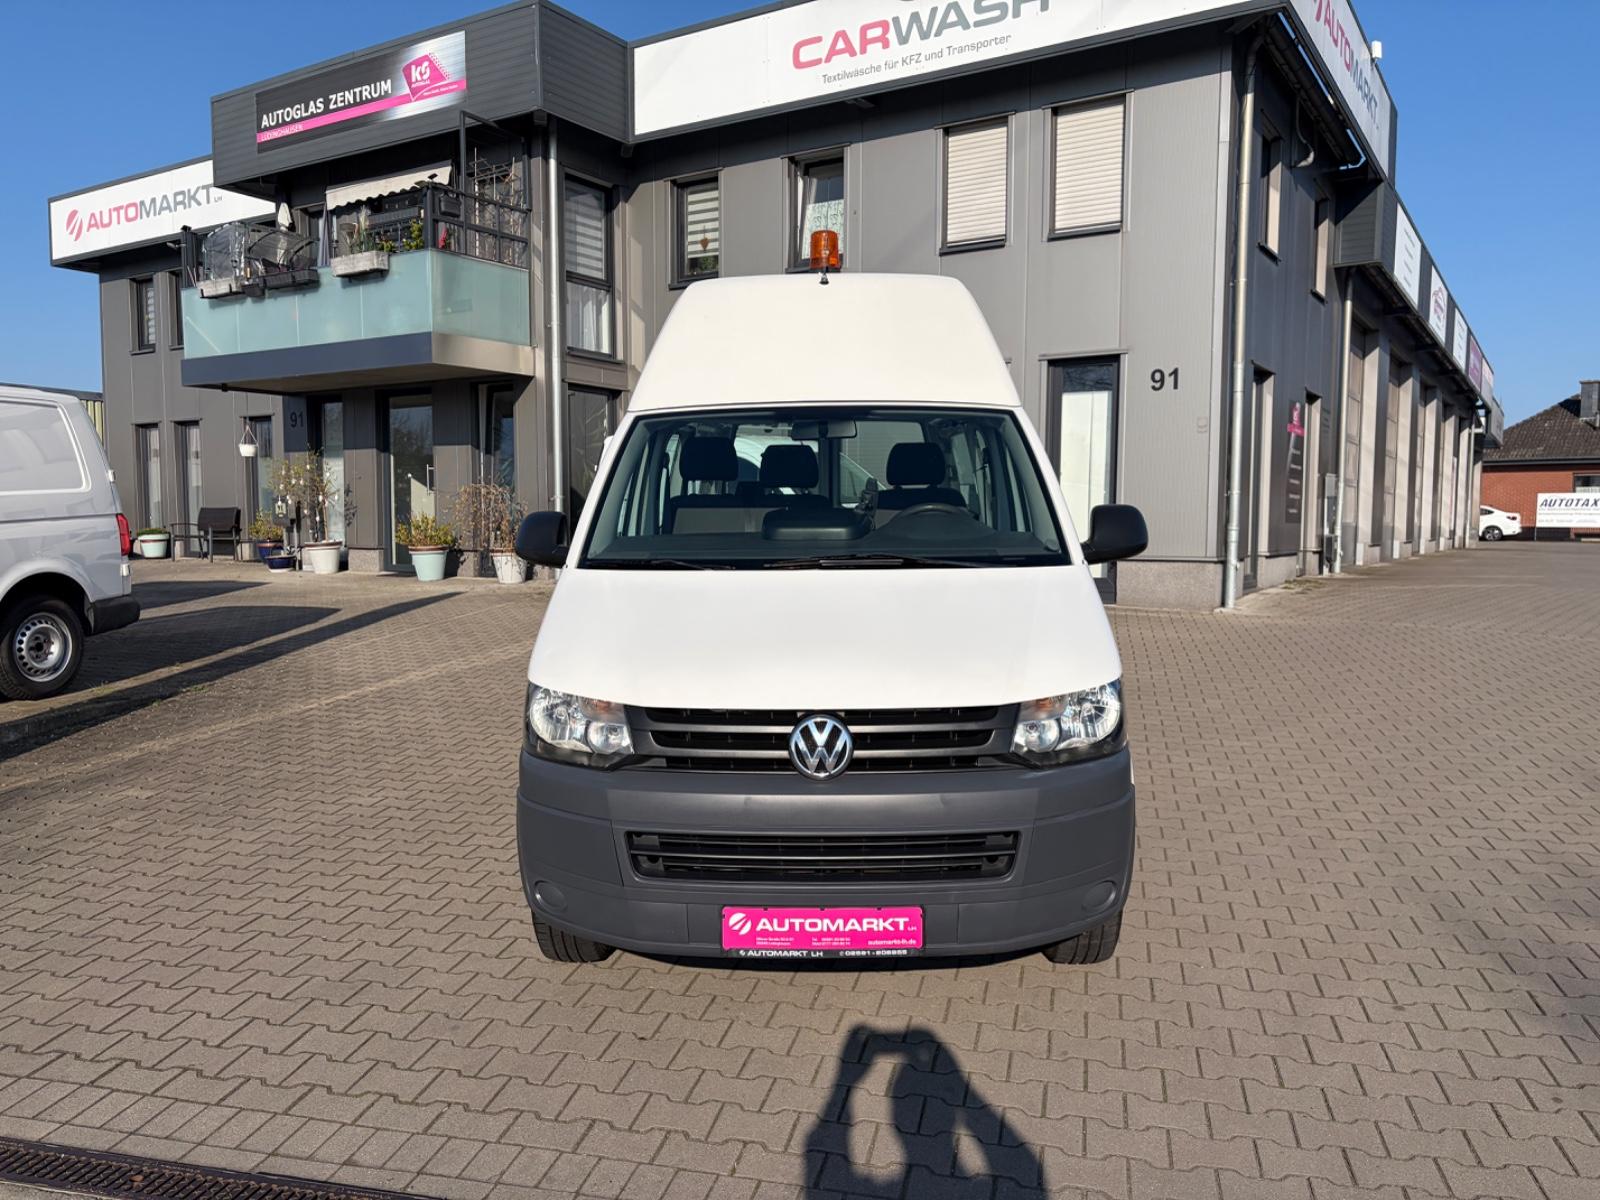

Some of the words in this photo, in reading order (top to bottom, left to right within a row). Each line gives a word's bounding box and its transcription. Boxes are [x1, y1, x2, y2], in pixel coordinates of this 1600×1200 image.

[822, 64, 881, 84] Textilwäsche
[883, 58, 899, 71] für
[901, 53, 922, 67] KFZ
[924, 50, 943, 62] und
[946, 34, 1011, 57] Transporter
[1323, 0, 1377, 124] AUTOMARKT
[261, 98, 324, 128] AUTOGLAS
[328, 79, 391, 110] ZENTRUM
[86, 184, 213, 232] AUTOMARKT
[1151, 367, 1179, 391] 91
[290, 411, 304, 428] 91
[756, 917, 909, 932] AUTOMARKT
